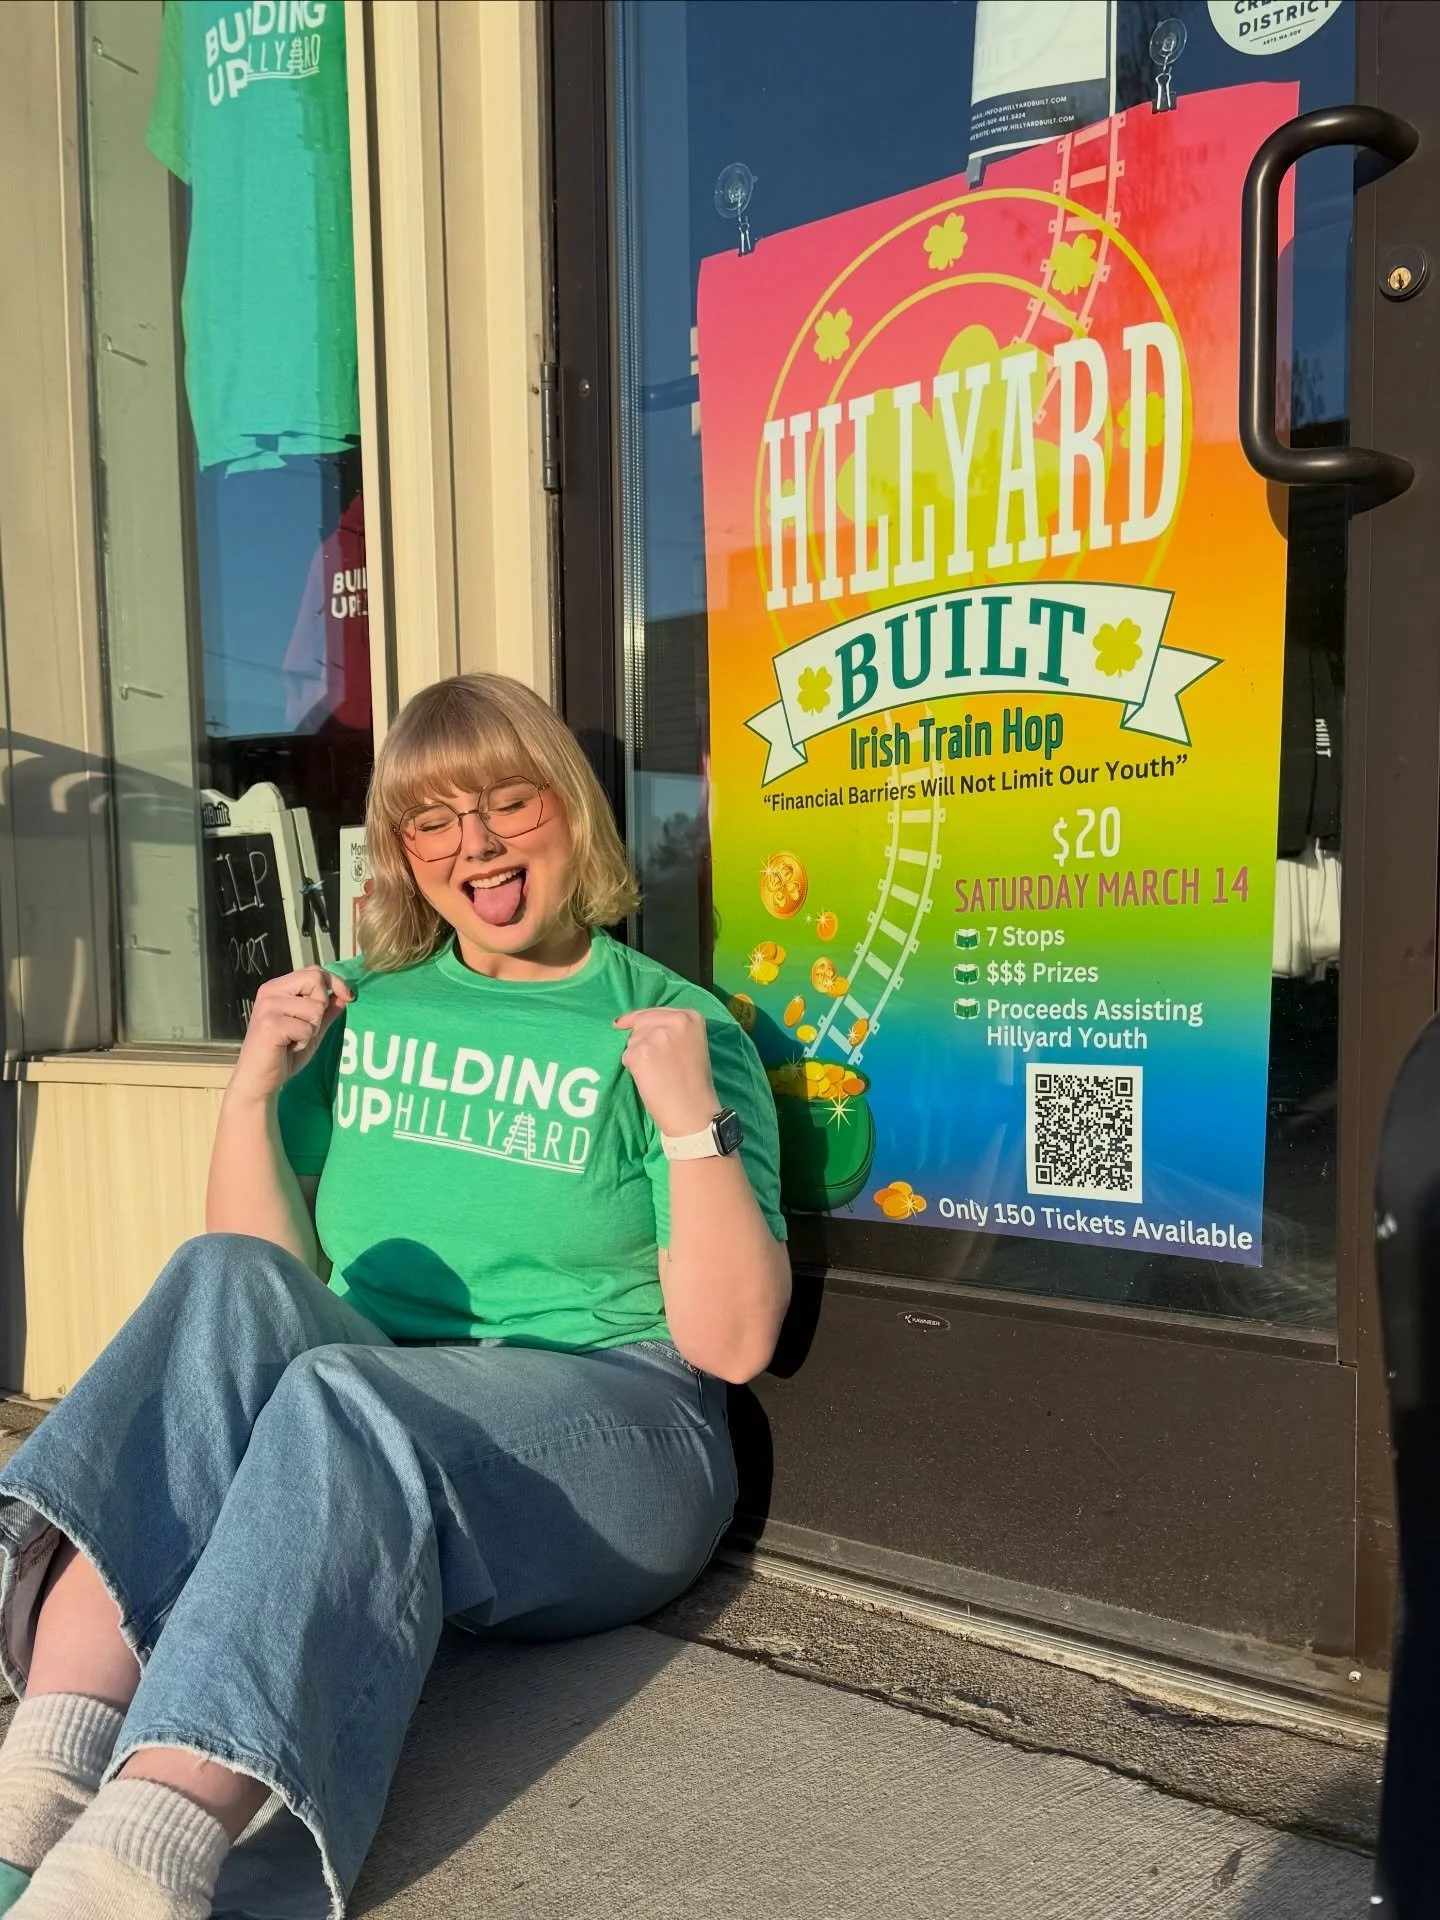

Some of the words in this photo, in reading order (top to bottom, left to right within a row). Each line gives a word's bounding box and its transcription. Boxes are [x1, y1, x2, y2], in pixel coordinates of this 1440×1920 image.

[208, 58, 251, 107] UP
[763, 321, 1184, 611] HILLYARD
[834, 595, 1086, 721] BUILT
[850, 722, 910, 770] Irish
[919, 714, 992, 763] Train
[1002, 707, 1064, 760] Hop
[763, 787, 844, 811] “Financial
[849, 782, 916, 804] Barriers
[920, 776, 955, 797] Will
[960, 774, 996, 794] Not
[1001, 767, 1053, 791] Limit
[1059, 765, 1099, 785] Our
[1105, 754, 1188, 781] Youth”
[1053, 806, 1121, 867] $20
[955, 872, 1089, 913] SATURDAY
[1098, 868, 1199, 907] MARCH
[1212, 866, 1249, 904] 14
[986, 926, 998, 947] 7
[1002, 926, 1065, 951] Stops
[986, 960, 1026, 985] $$$
[1033, 962, 1099, 983] Prizes
[987, 998, 1088, 1020] Proceeds
[1093, 998, 1204, 1026] Assisting
[987, 1026, 1072, 1052] Hillyard
[1077, 1027, 1148, 1050] Youth
[338, 1028, 600, 1118] BUILDING
[337, 1082, 392, 1133] UP
[394, 1091, 591, 1165] HILLYARD
[939, 1197, 988, 1226] Only
[994, 1203, 1036, 1226] 150
[1040, 1207, 1126, 1237] Tickets
[1132, 1215, 1253, 1250] Available
